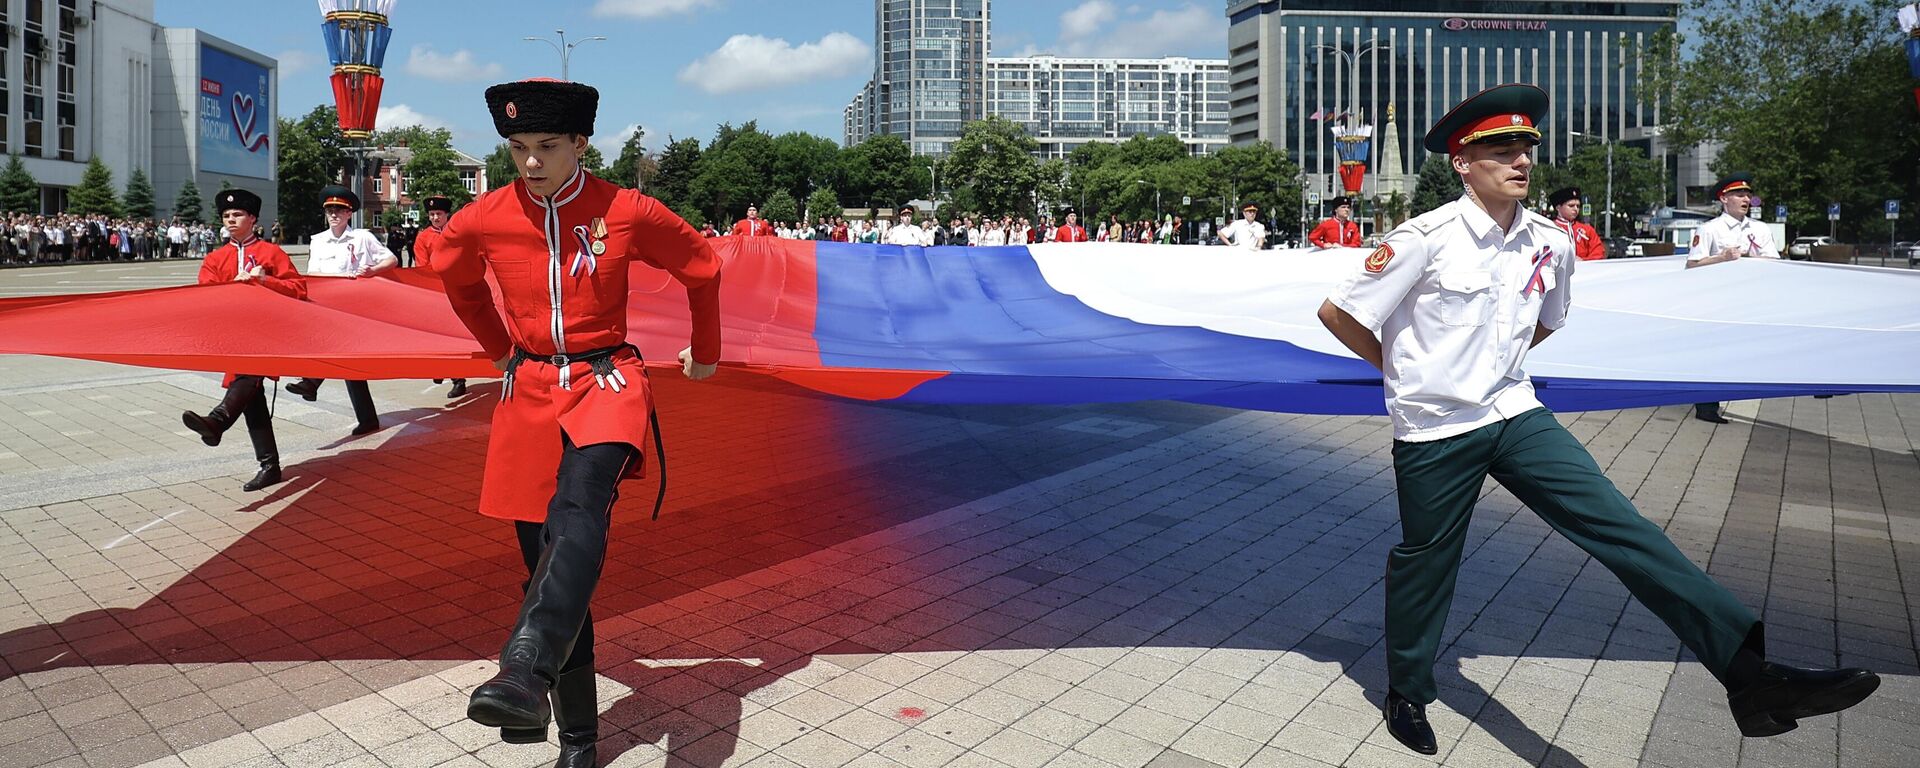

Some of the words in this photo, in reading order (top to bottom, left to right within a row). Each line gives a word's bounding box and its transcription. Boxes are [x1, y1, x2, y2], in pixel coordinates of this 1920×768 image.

[1471, 20, 1512, 30] CROWNE
[1516, 21, 1547, 30] PLAZA
[203, 80, 208, 91] 12
[200, 96, 221, 118] ДЕНЬ
[200, 118, 229, 141] РОССИИ
